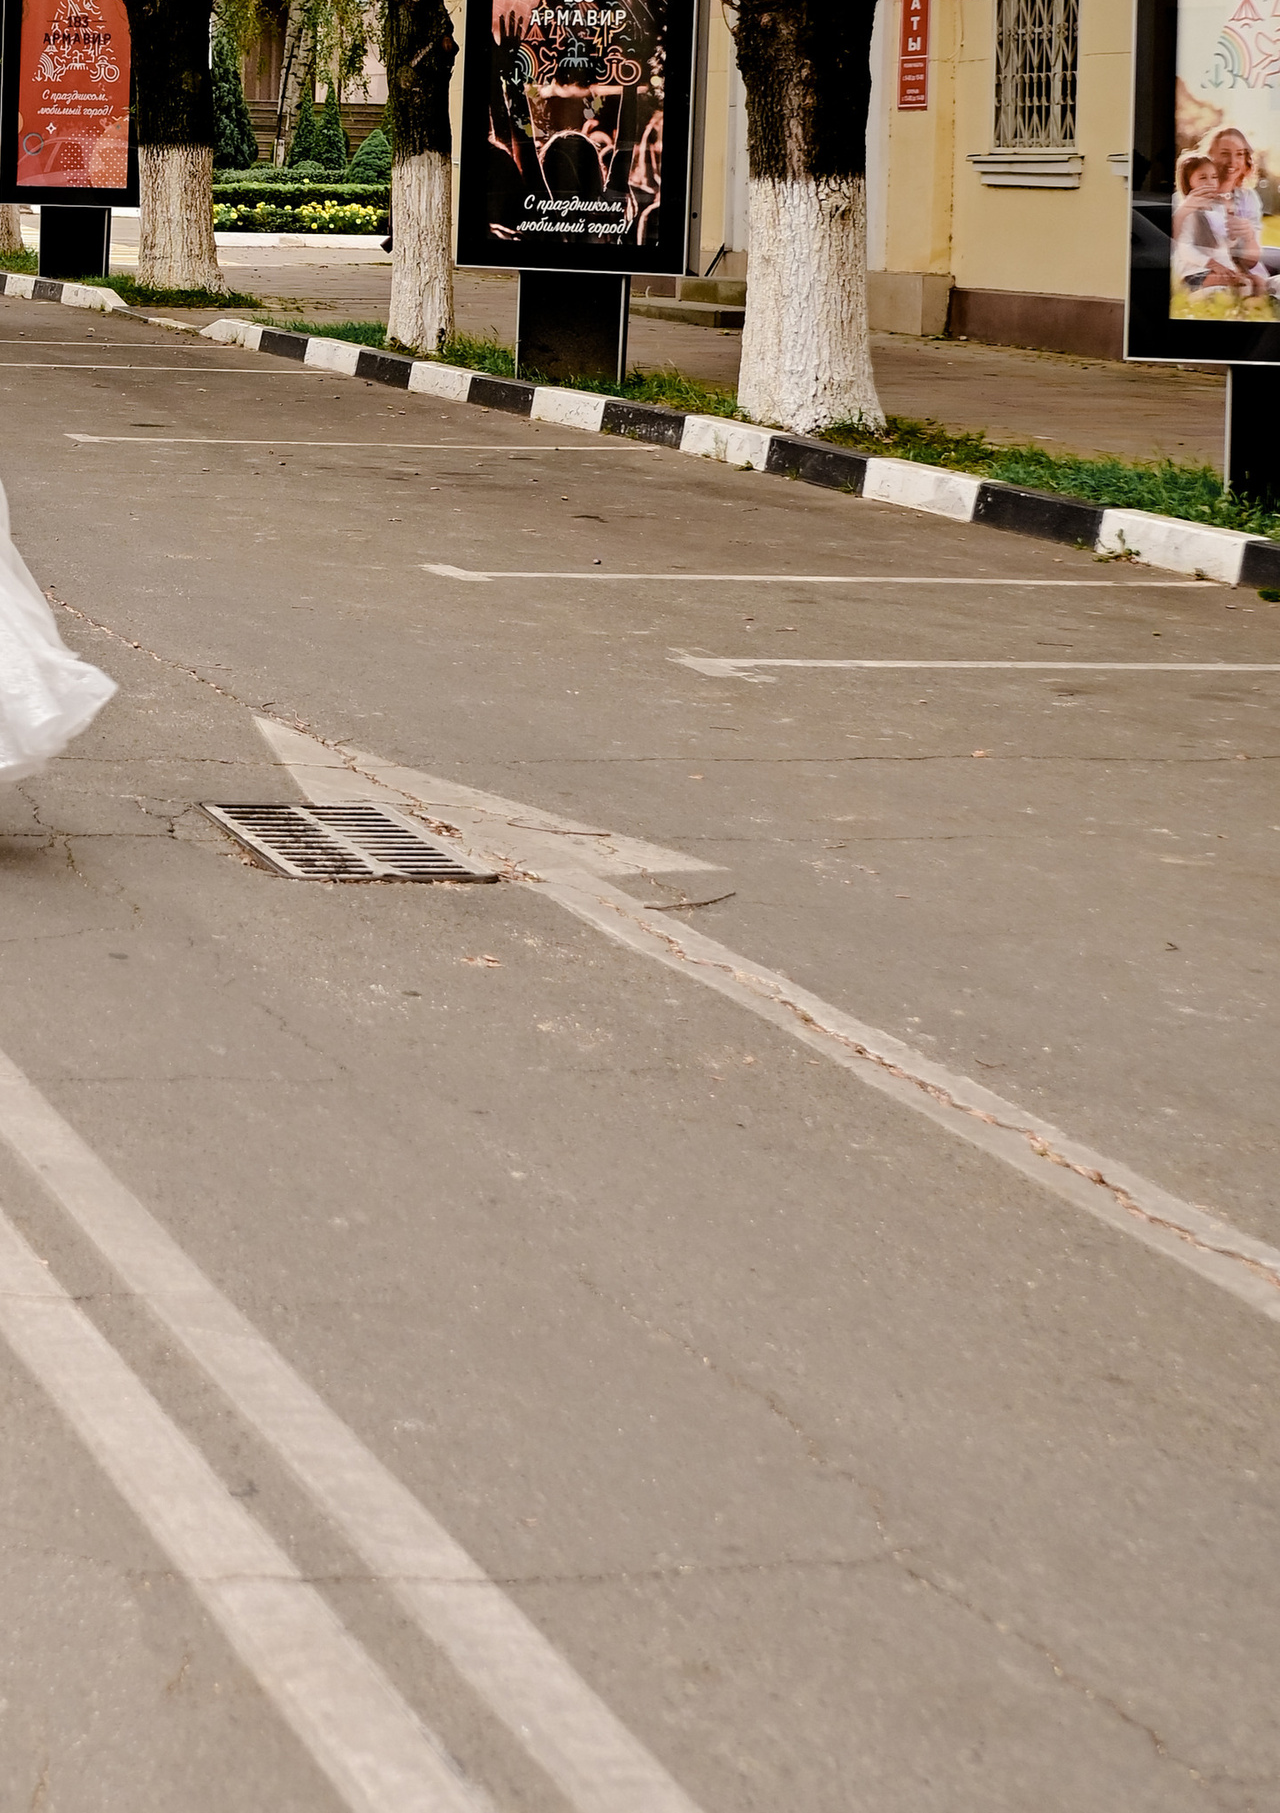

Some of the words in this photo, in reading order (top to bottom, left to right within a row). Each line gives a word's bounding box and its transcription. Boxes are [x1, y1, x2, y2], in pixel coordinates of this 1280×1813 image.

[67, 15, 89, 28] 183
[529, 9, 627, 26] АРМАВИР
[43, 32, 112, 45] АРМАВИР
[42, 89, 50, 100] С
[37, 104, 82, 115] любимый
[83, 105, 114, 118] город!
[524, 194, 536, 210] С
[516, 216, 586, 233] любимый
[588, 218, 634, 238] город!
